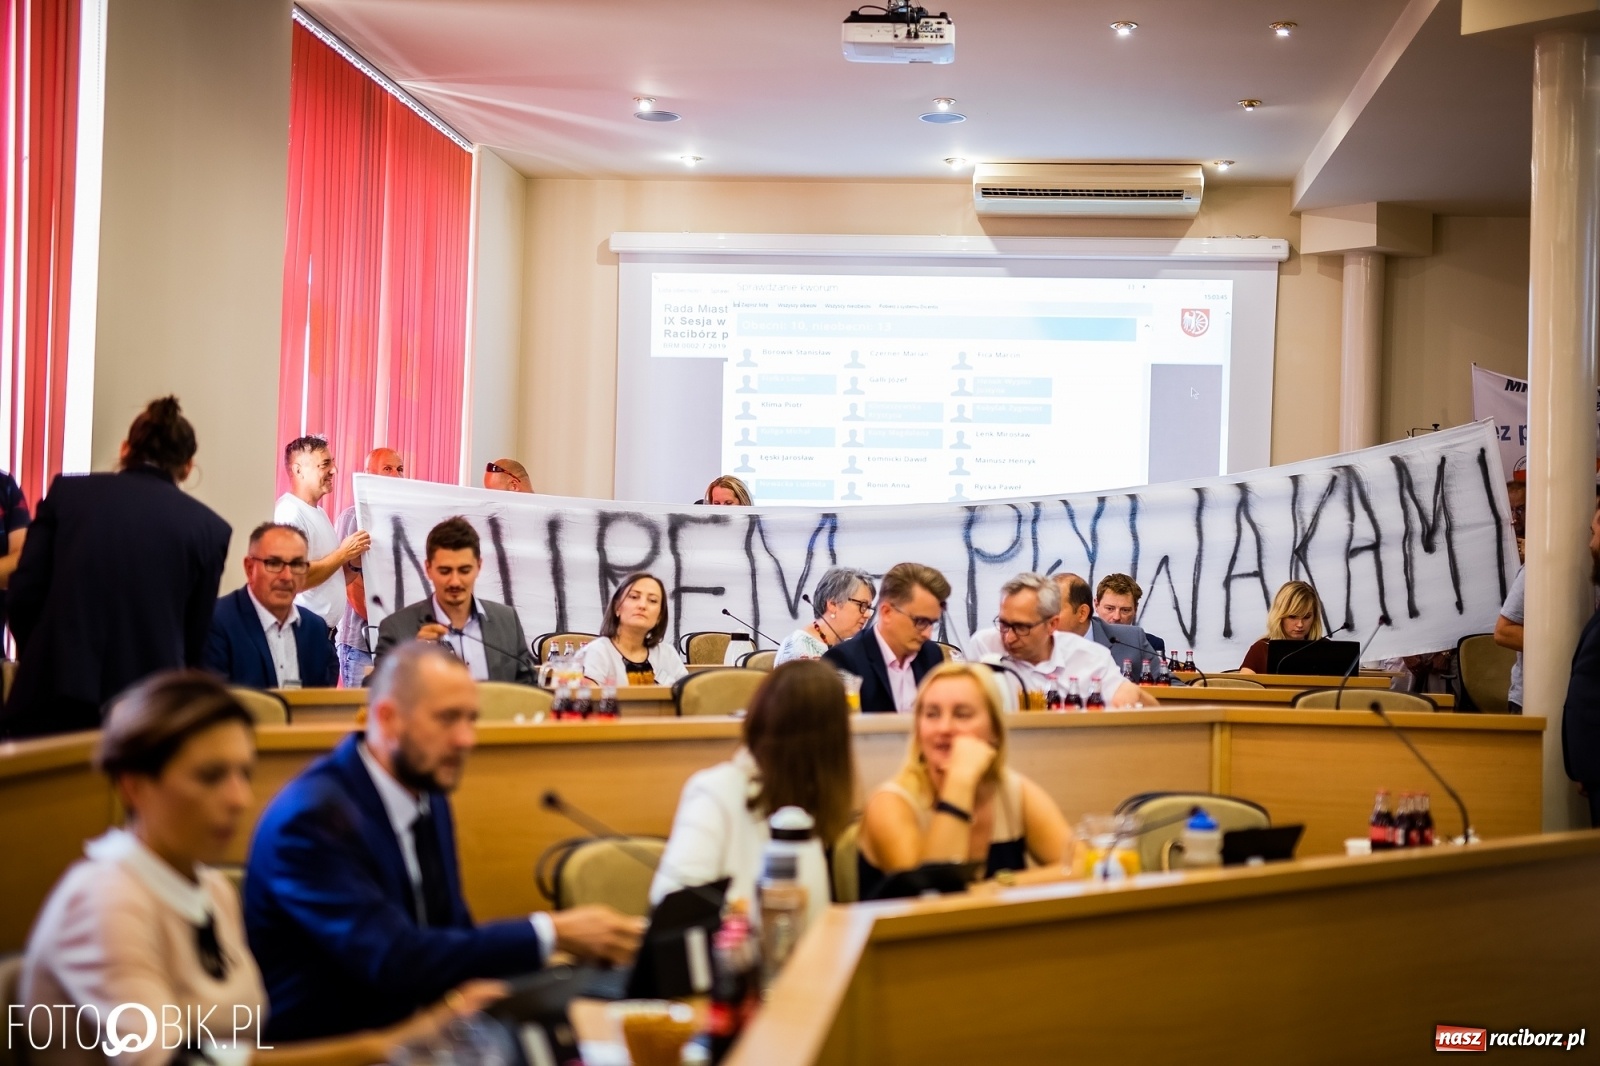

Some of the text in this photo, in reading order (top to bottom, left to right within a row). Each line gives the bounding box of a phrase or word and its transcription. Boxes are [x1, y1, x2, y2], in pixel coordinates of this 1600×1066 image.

[736, 282, 839, 292] Sprawdzanie kworum
[664, 303, 694, 313] Rada
[664, 316, 726, 328] IX Sesja w
[742, 319, 787, 331] Obecni:
[664, 329, 718, 339] Racibórz
[762, 348, 832, 356] Borowik Stanisław
[995, 351, 1021, 359] Marcin
[887, 376, 908, 385] Józef
[781, 454, 815, 462] Jarosław
[903, 455, 928, 463] Dawid
[1008, 458, 1036, 466] Henryk
[866, 481, 889, 489] Ronin
[974, 483, 1022, 491] Rycka Paweł
